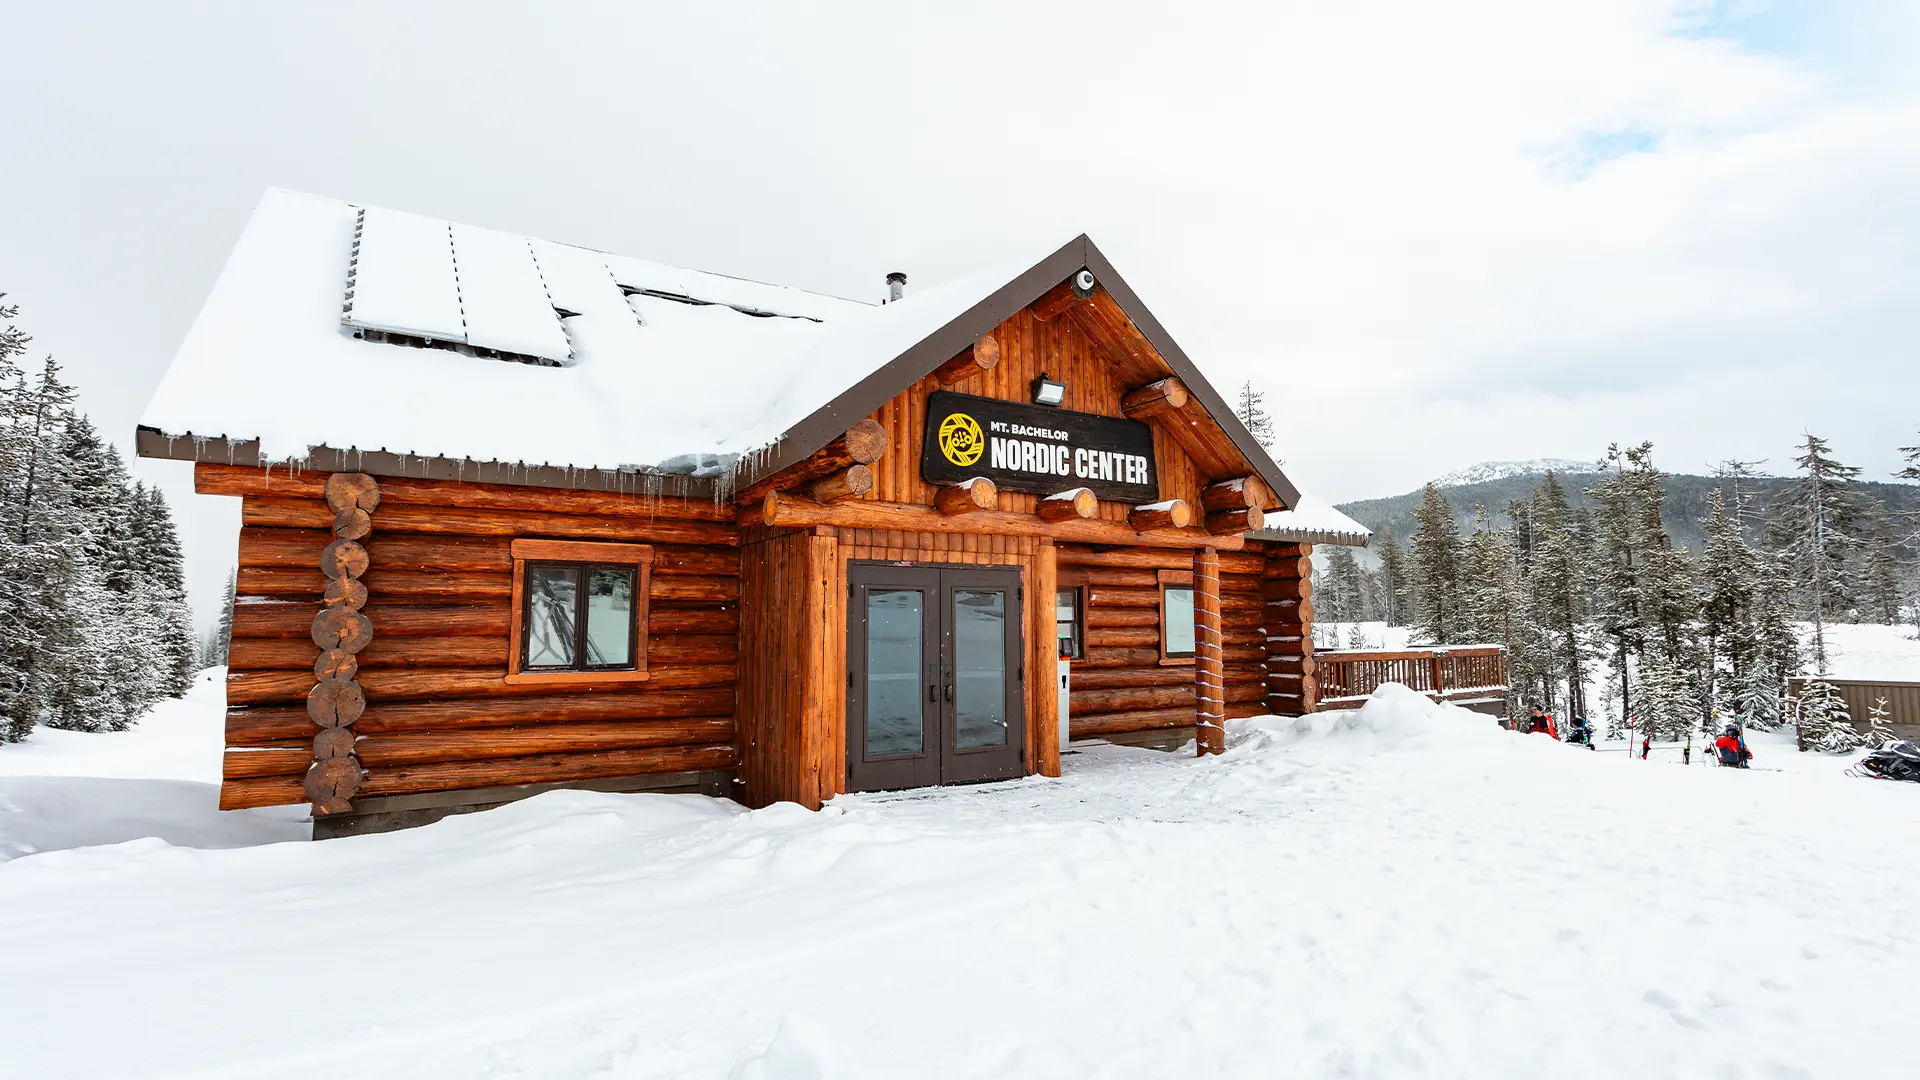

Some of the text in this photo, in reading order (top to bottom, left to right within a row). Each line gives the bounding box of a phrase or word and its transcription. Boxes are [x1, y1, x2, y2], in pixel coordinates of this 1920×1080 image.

[990, 421, 1069, 441] MT. BACHELOR
[990, 437, 1148, 485] NORDIC CENTER
